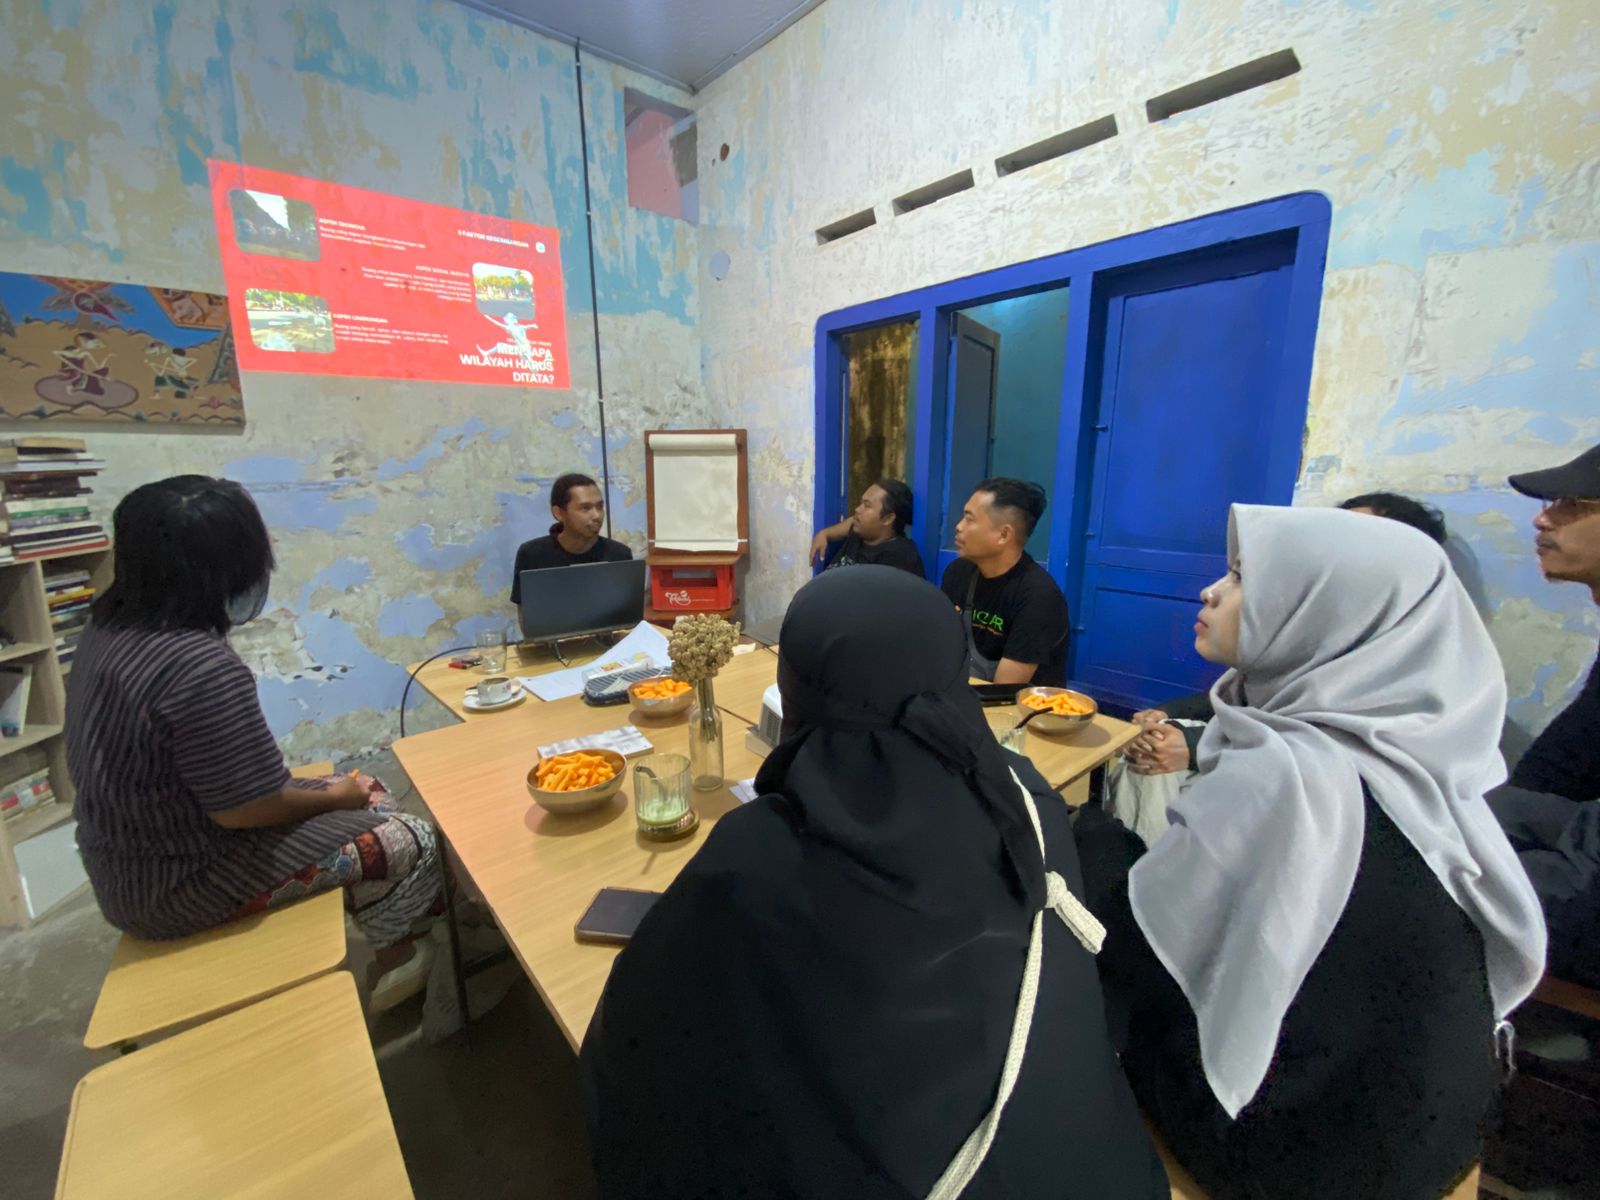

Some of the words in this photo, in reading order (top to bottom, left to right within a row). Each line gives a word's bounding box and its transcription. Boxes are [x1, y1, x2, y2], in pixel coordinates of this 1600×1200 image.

[459, 353, 513, 368] WILAYAH
[515, 358, 555, 372] HARUS
[512, 371, 556, 385] DITATA?
